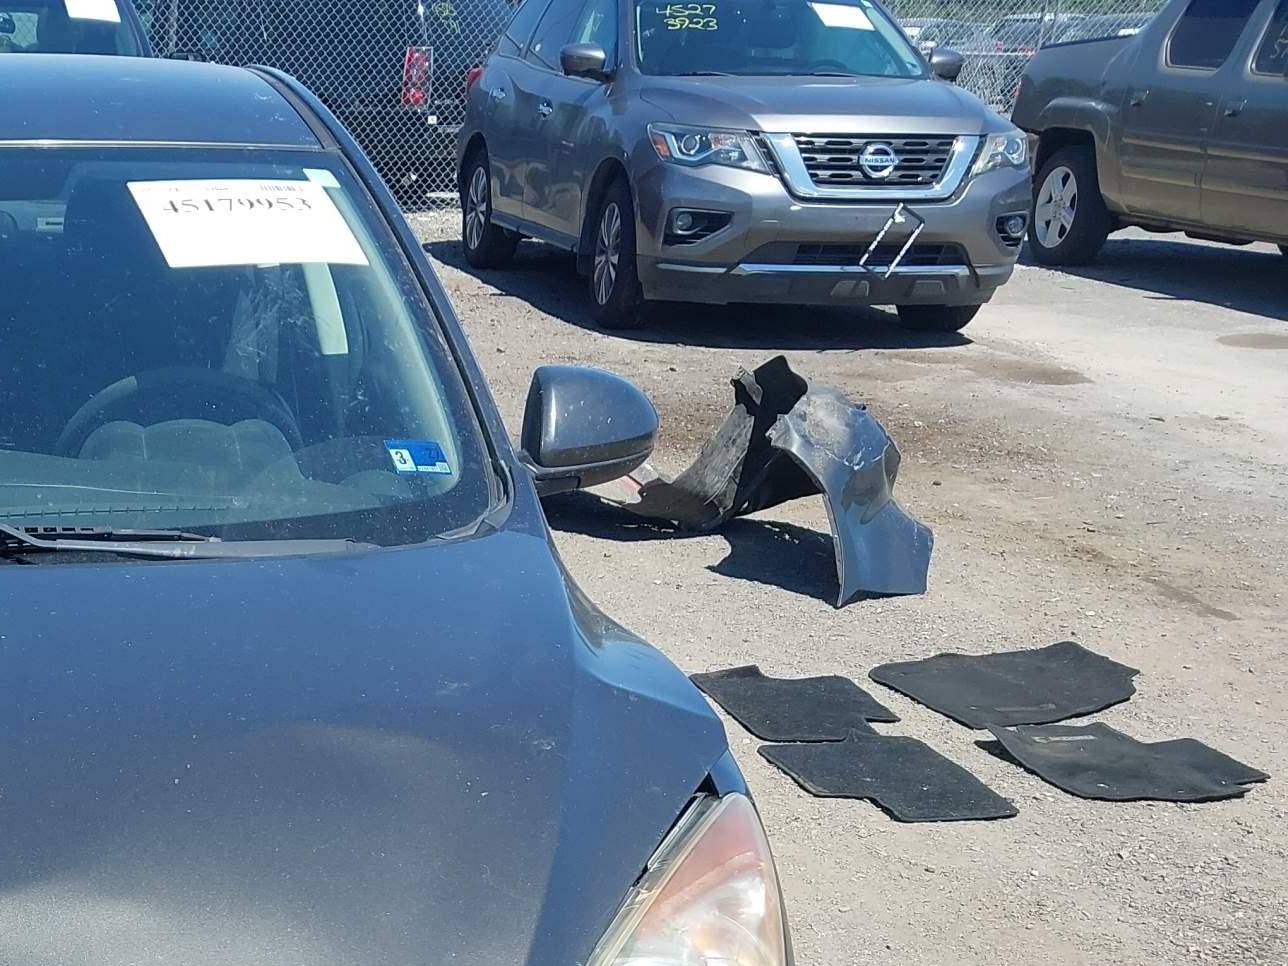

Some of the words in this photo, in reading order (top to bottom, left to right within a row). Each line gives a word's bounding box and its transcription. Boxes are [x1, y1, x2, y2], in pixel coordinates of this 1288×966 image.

[655, 3, 716, 17] 4527
[663, 17, 718, 30] 3923
[162, 197, 312, 214] 45179953
[395, 450, 407, 464] 3
